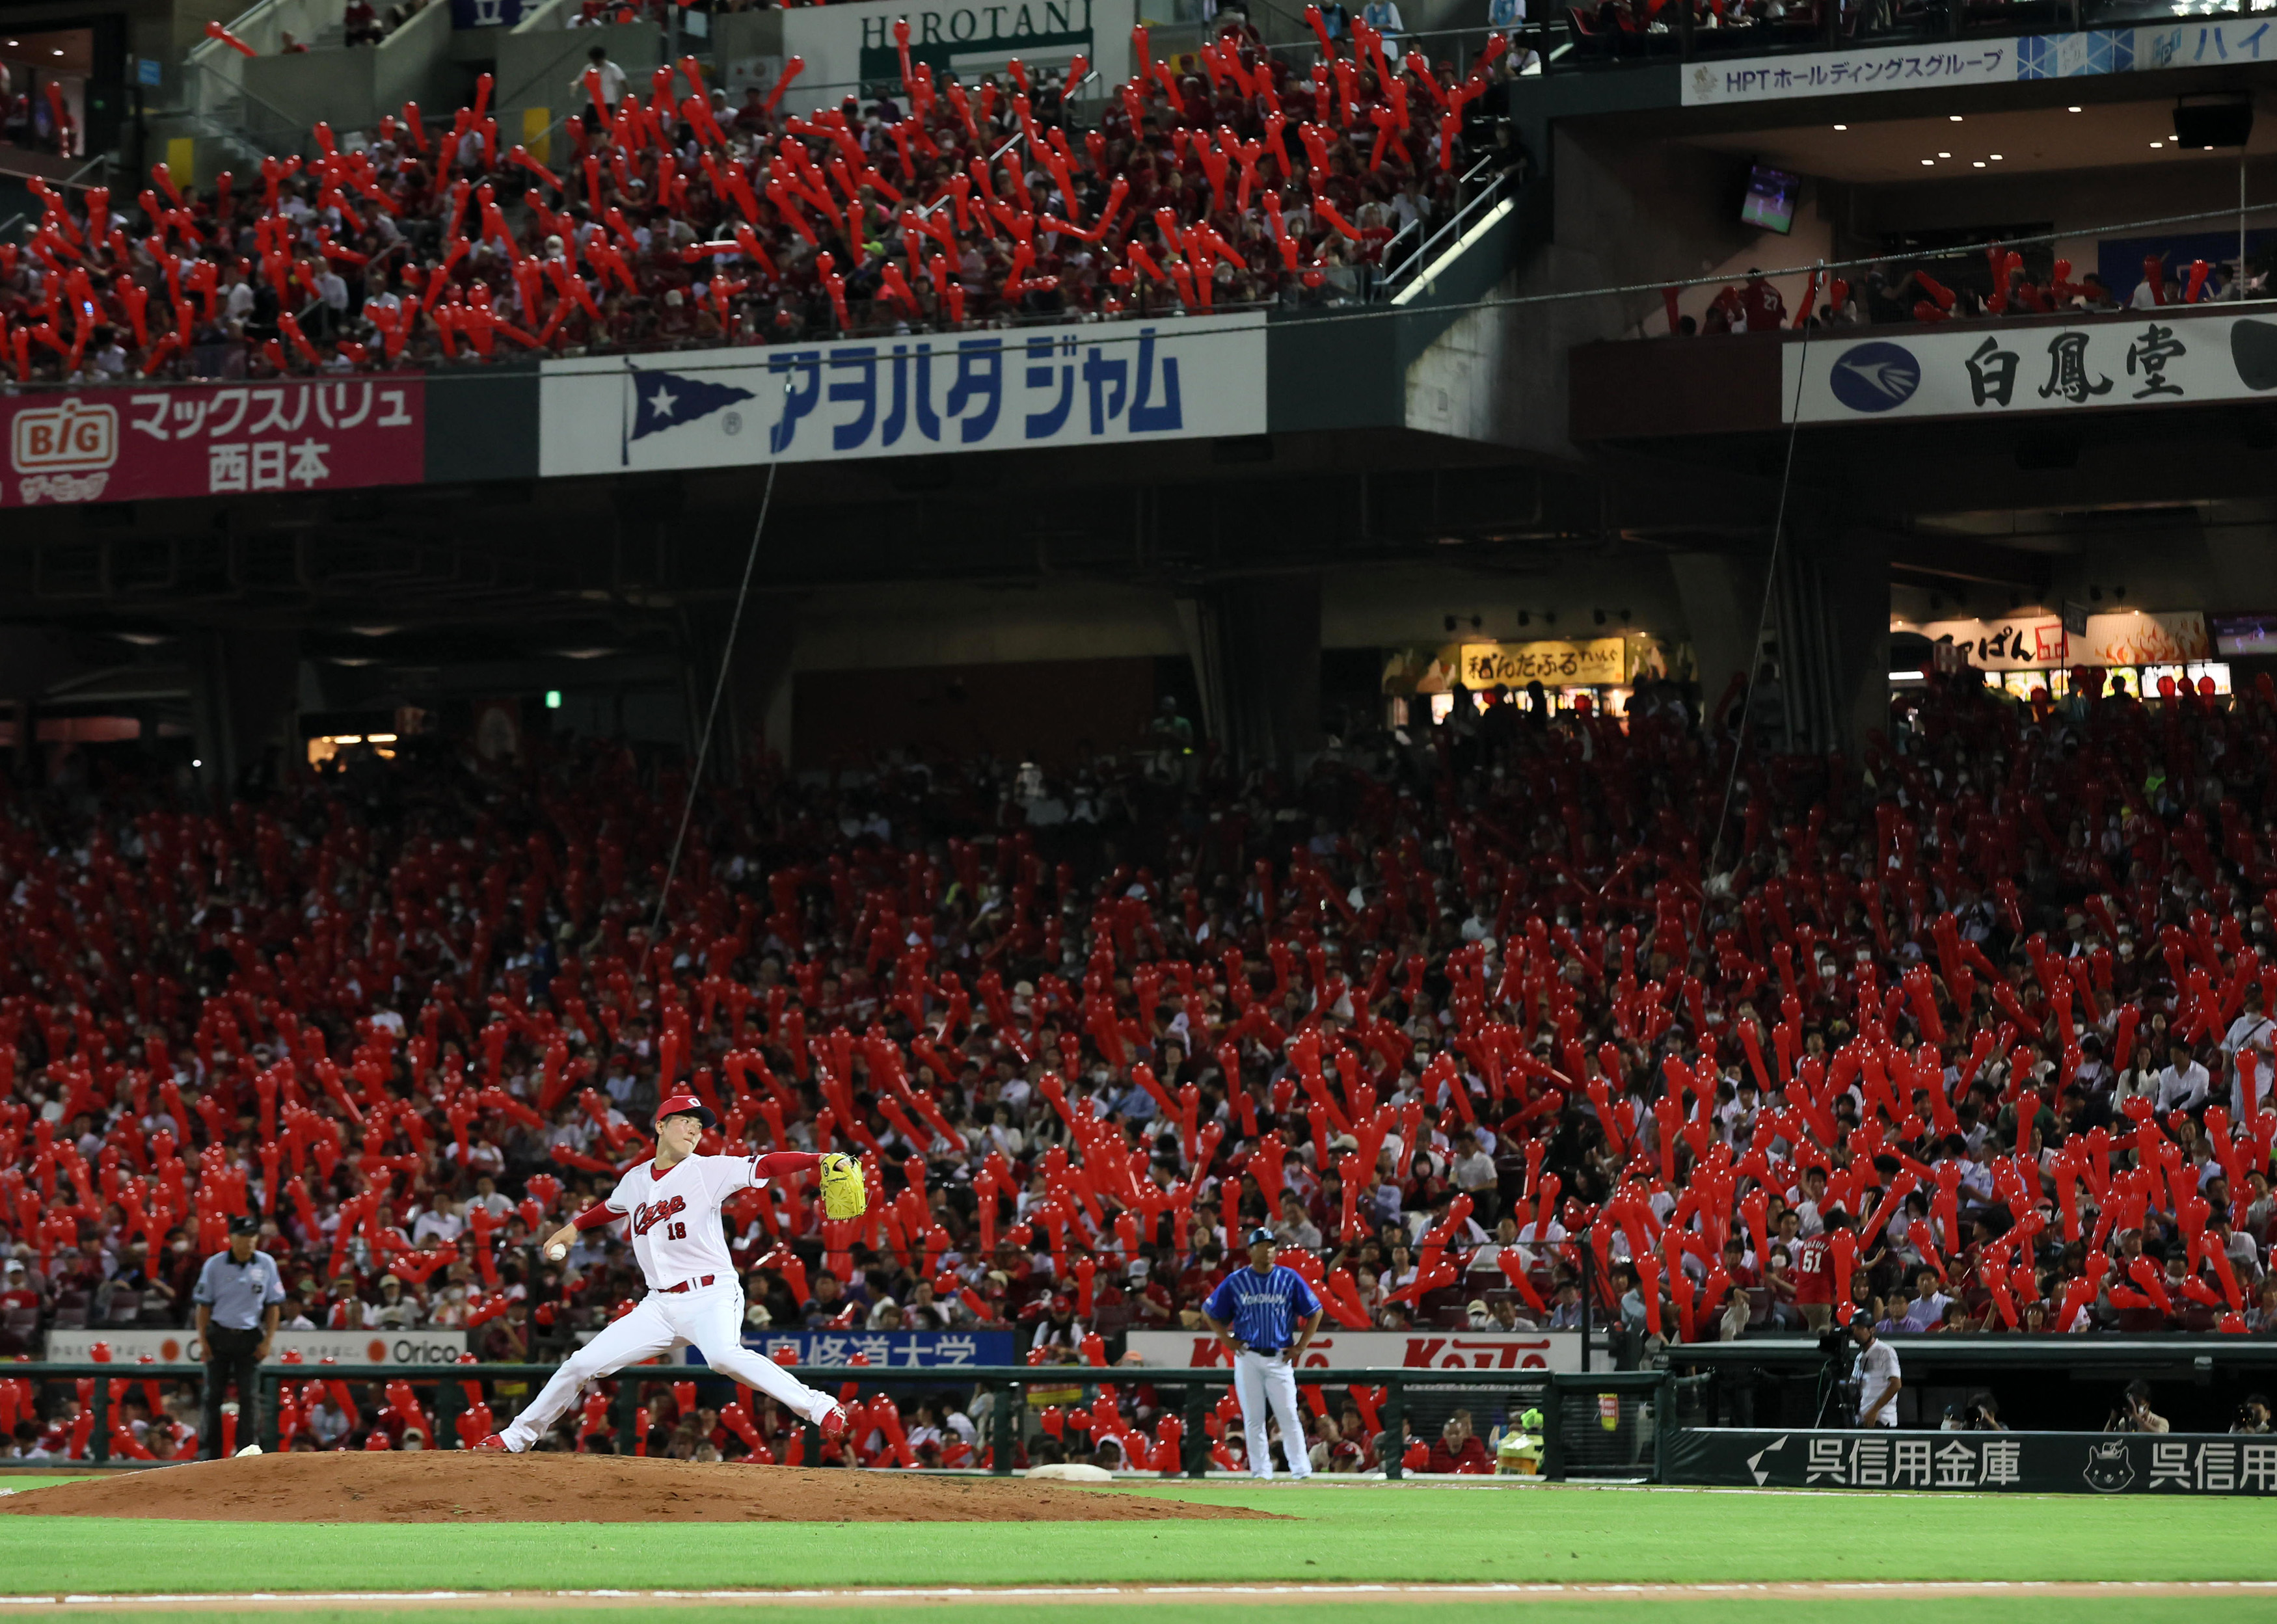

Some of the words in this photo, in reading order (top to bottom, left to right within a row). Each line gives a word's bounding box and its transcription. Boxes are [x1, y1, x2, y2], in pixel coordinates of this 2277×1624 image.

[862, 0, 1094, 49] HROTANI
[1965, 323, 2187, 408] 白鳳堂
[209, 438, 330, 493] 西日本
[633, 1195, 686, 1238] Carp
[667, 1221, 687, 1241] 18
[1802, 1250, 1822, 1273] 51
[393, 1339, 457, 1363] Orico
[741, 1335, 976, 1366] 島修道大学
[1806, 1439, 2021, 1486] 呉信用金庫
[2149, 1442, 2277, 1490] 呉信用
